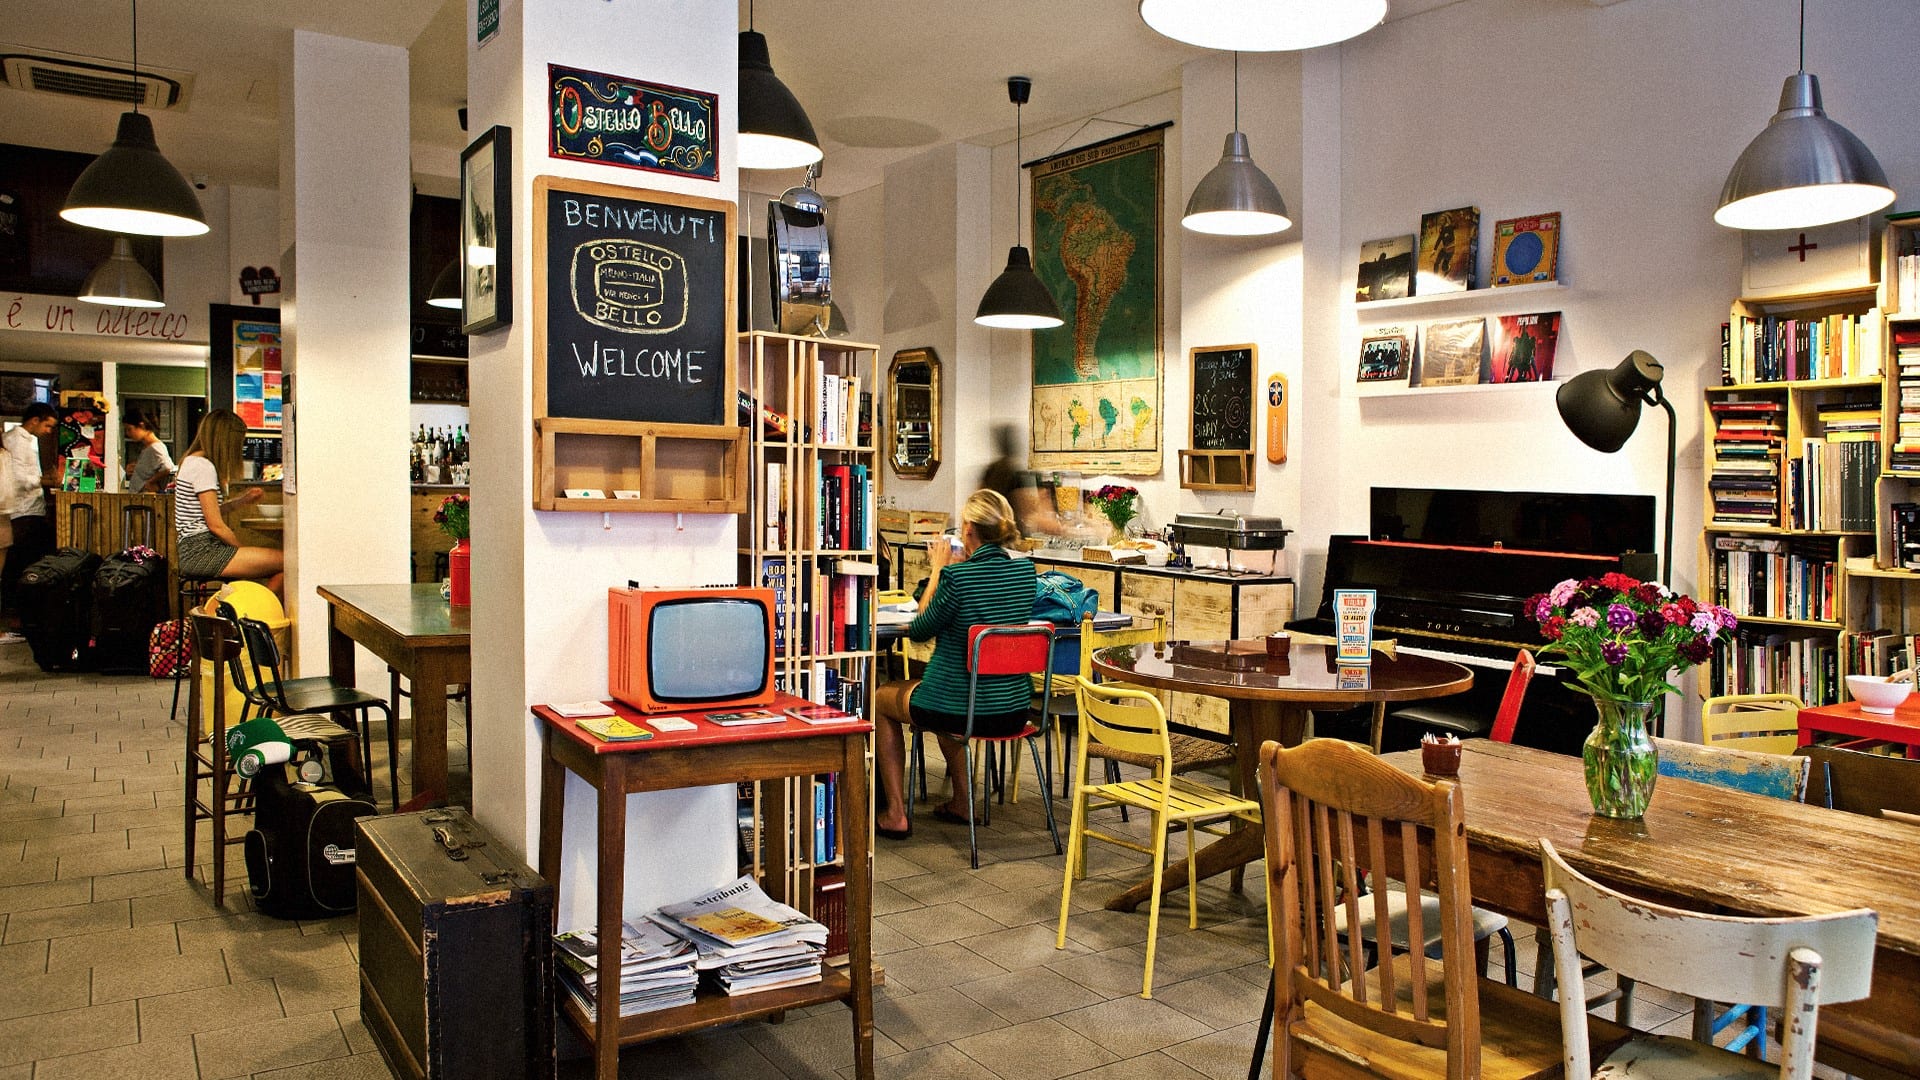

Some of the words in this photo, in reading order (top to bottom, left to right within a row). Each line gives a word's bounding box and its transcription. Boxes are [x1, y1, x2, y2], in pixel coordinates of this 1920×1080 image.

[558, 86, 642, 135] OSTELLO
[647, 100, 706, 151] BELLO
[590, 245, 673, 271] OSTELLO
[643, 292, 650, 302] 4
[46, 304, 75, 332] un
[594, 302, 662, 326] BELLO
[571, 340, 707, 384] WELCOME
